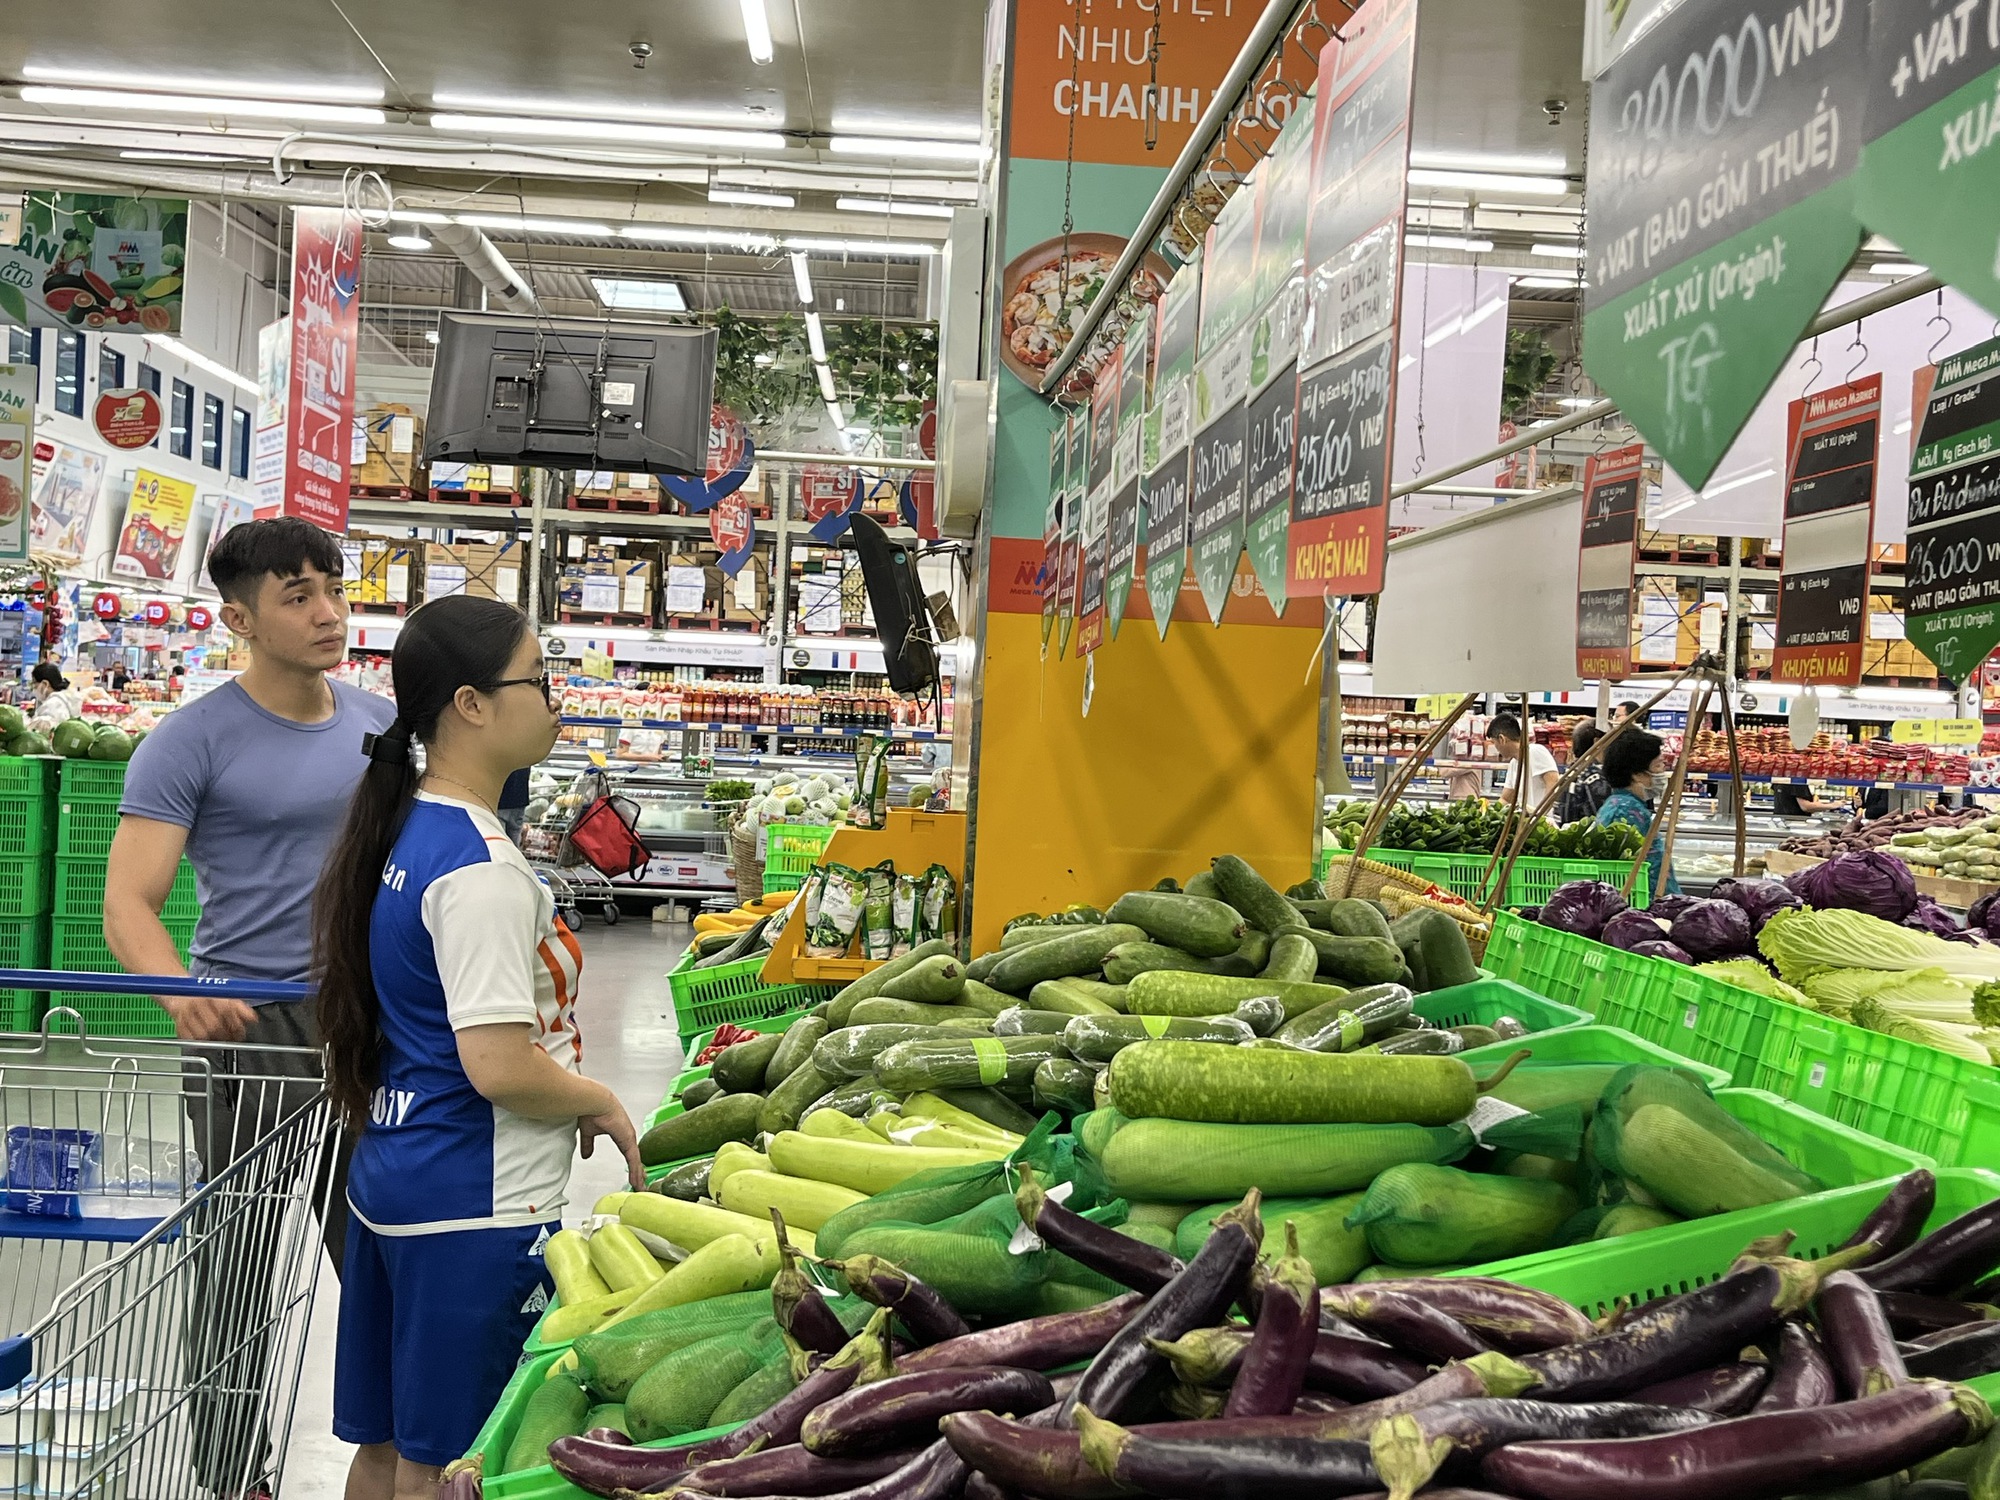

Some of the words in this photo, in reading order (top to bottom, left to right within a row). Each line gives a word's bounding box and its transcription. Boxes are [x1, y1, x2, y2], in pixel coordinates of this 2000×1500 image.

[1053, 79, 1199, 123] CHANH
[1597, 226, 1641, 287] +VAT
[1643, 196, 1691, 268] (BAO
[1697, 150, 1750, 231] GỒM
[1757, 86, 1840, 195] THUẾ)
[1622, 278, 1671, 344] XUẤT
[1674, 264, 1705, 321] XỨ
[1943, 449, 1952, 464] Kg
[1954, 442, 1977, 460] (Each
[1295, 522, 1341, 581] KHUYẾN
[1908, 537, 1983, 588] 26.000
[97, 598, 114, 613] 14
[1839, 597, 1860, 615] VNĐ
[1910, 593, 1933, 611] +VAT
[1934, 587, 1957, 609] (BAO
[148, 606, 164, 619] 13
[191, 611, 207, 625] 12
[1925, 613, 1947, 633] XUẤT
[1781, 648, 1825, 679] KHUYẾN
[1827, 651, 1849, 677] MÃI
